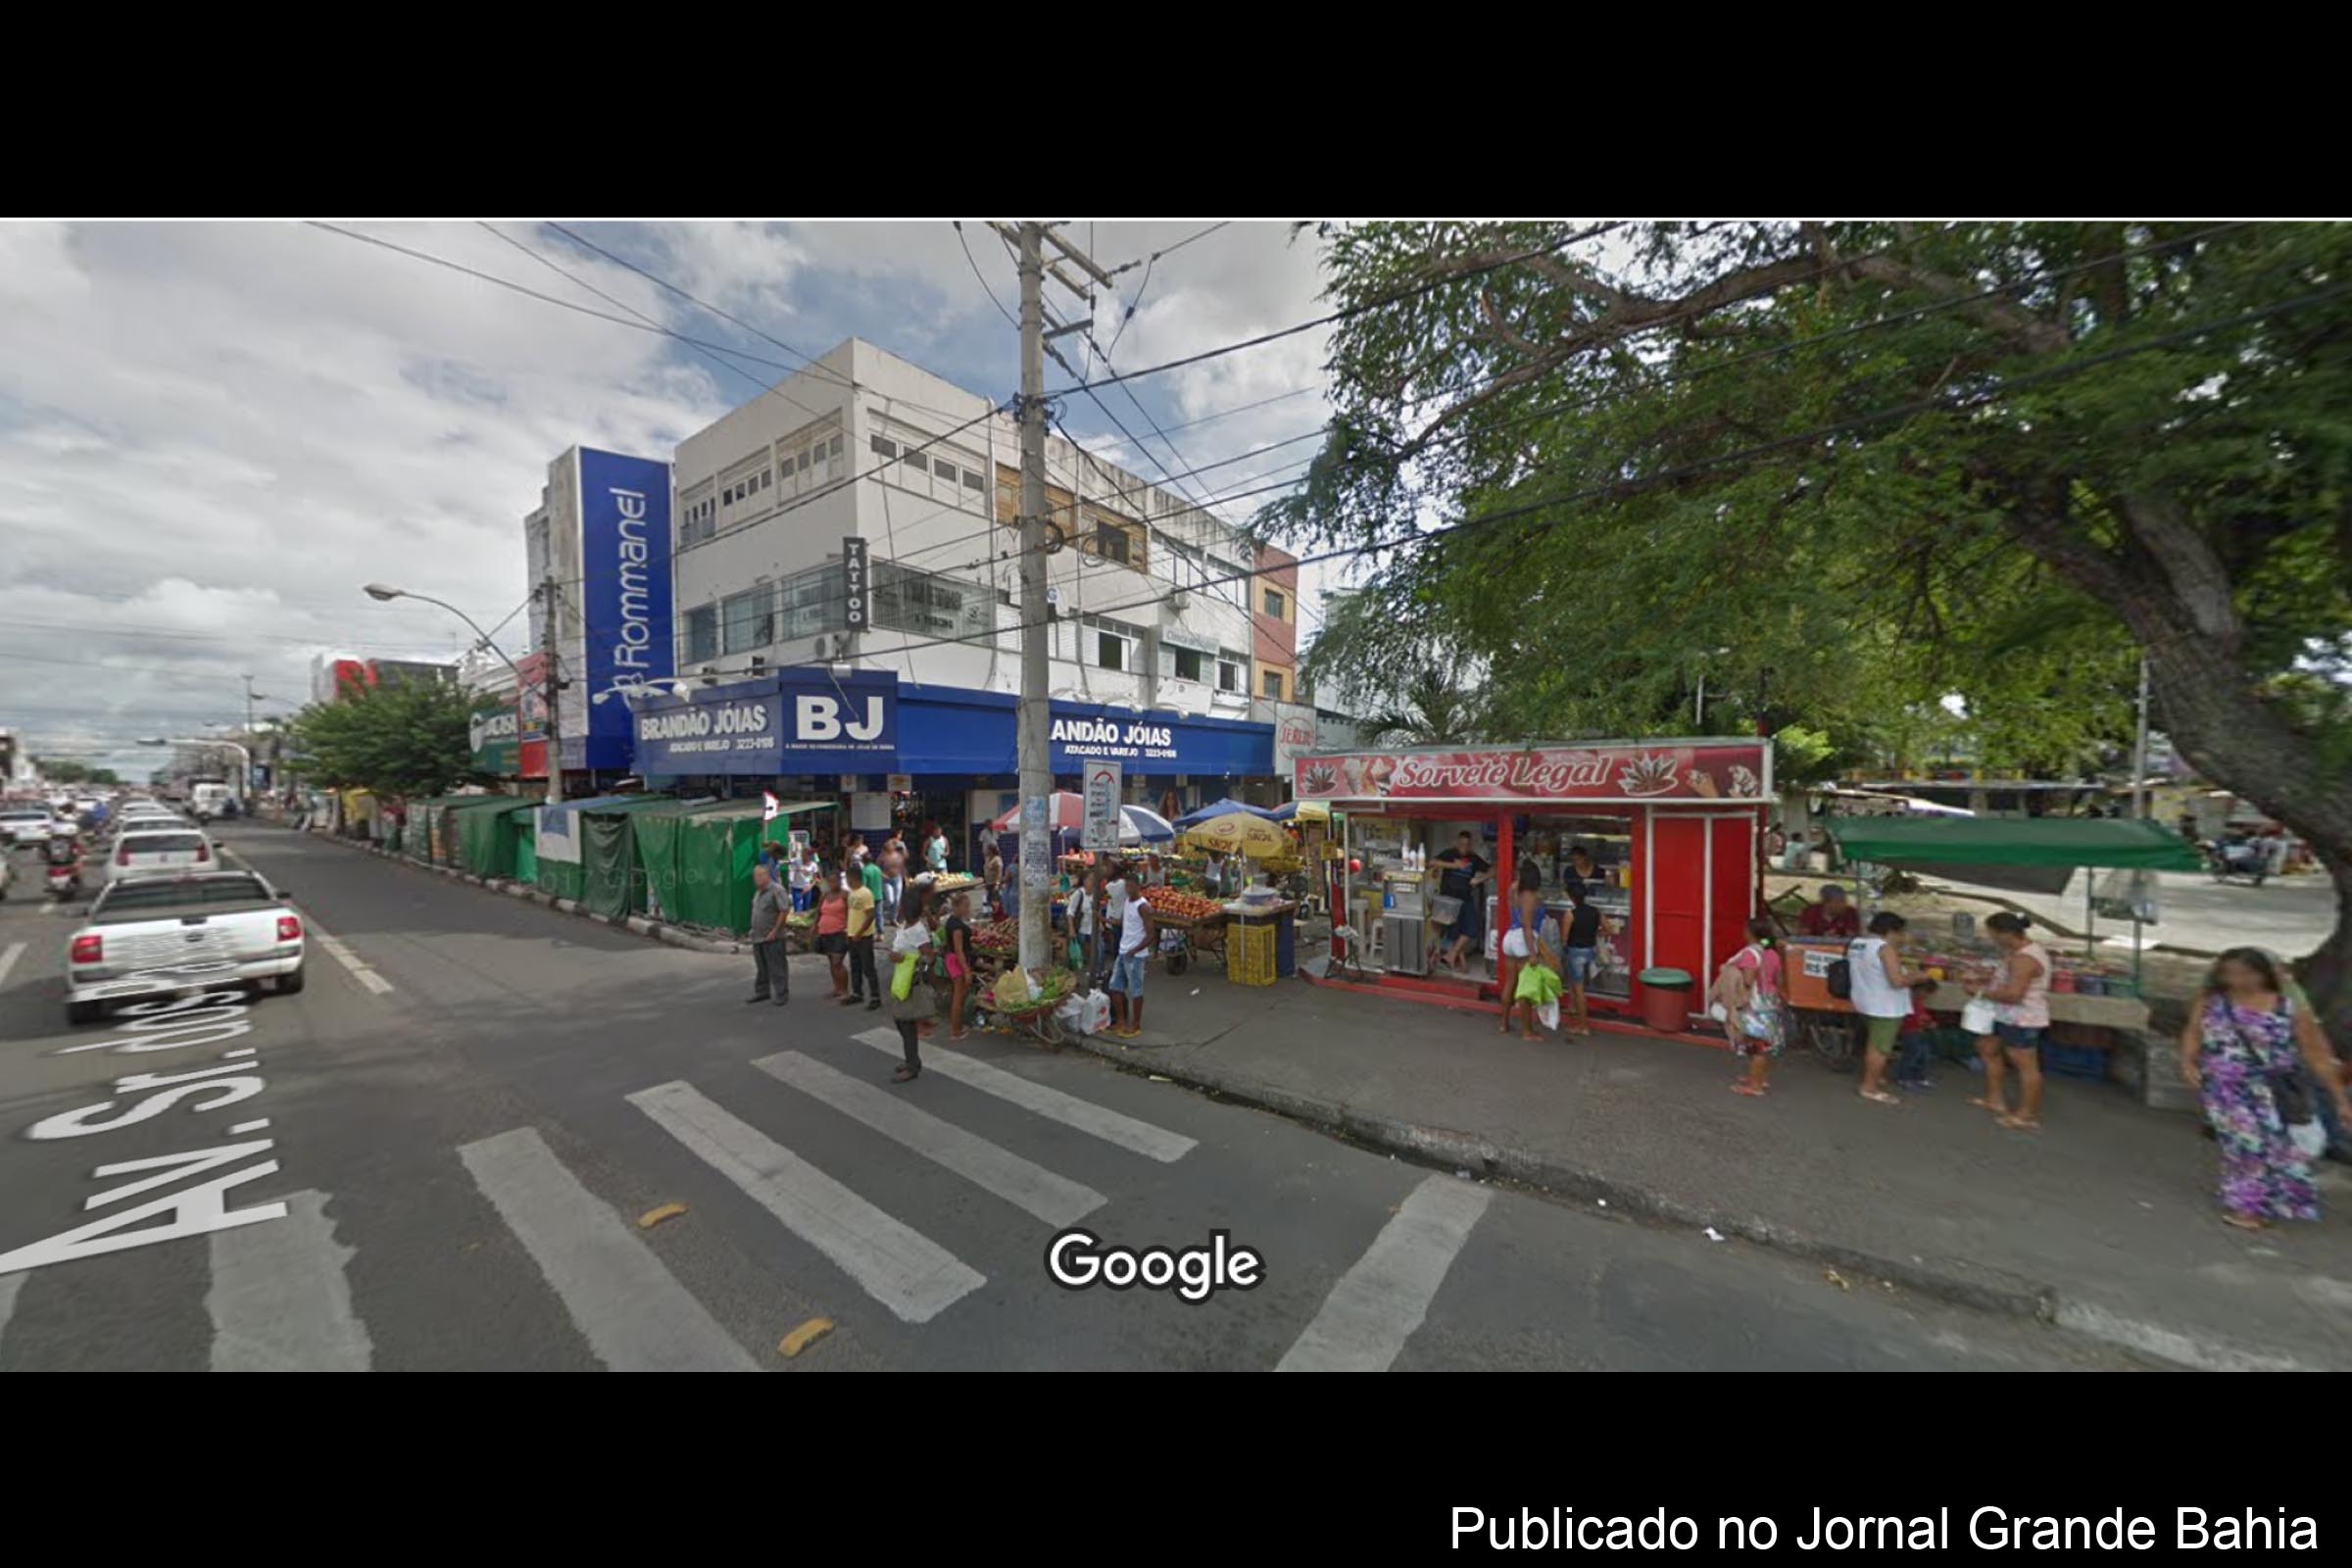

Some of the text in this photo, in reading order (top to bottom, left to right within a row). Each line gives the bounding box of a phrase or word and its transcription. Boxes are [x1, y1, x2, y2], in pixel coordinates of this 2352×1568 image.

[609, 487, 650, 668] Rommanel
[847, 543, 862, 623] TATTOO
[640, 702, 767, 740] BRANDÃO JÓIAS
[796, 695, 884, 742] BJ
[1050, 717, 1172, 747] ANDÃO JÓIAS
[1064, 744, 1102, 756] ATACADO
[1510, 755, 1613, 793] Legal
